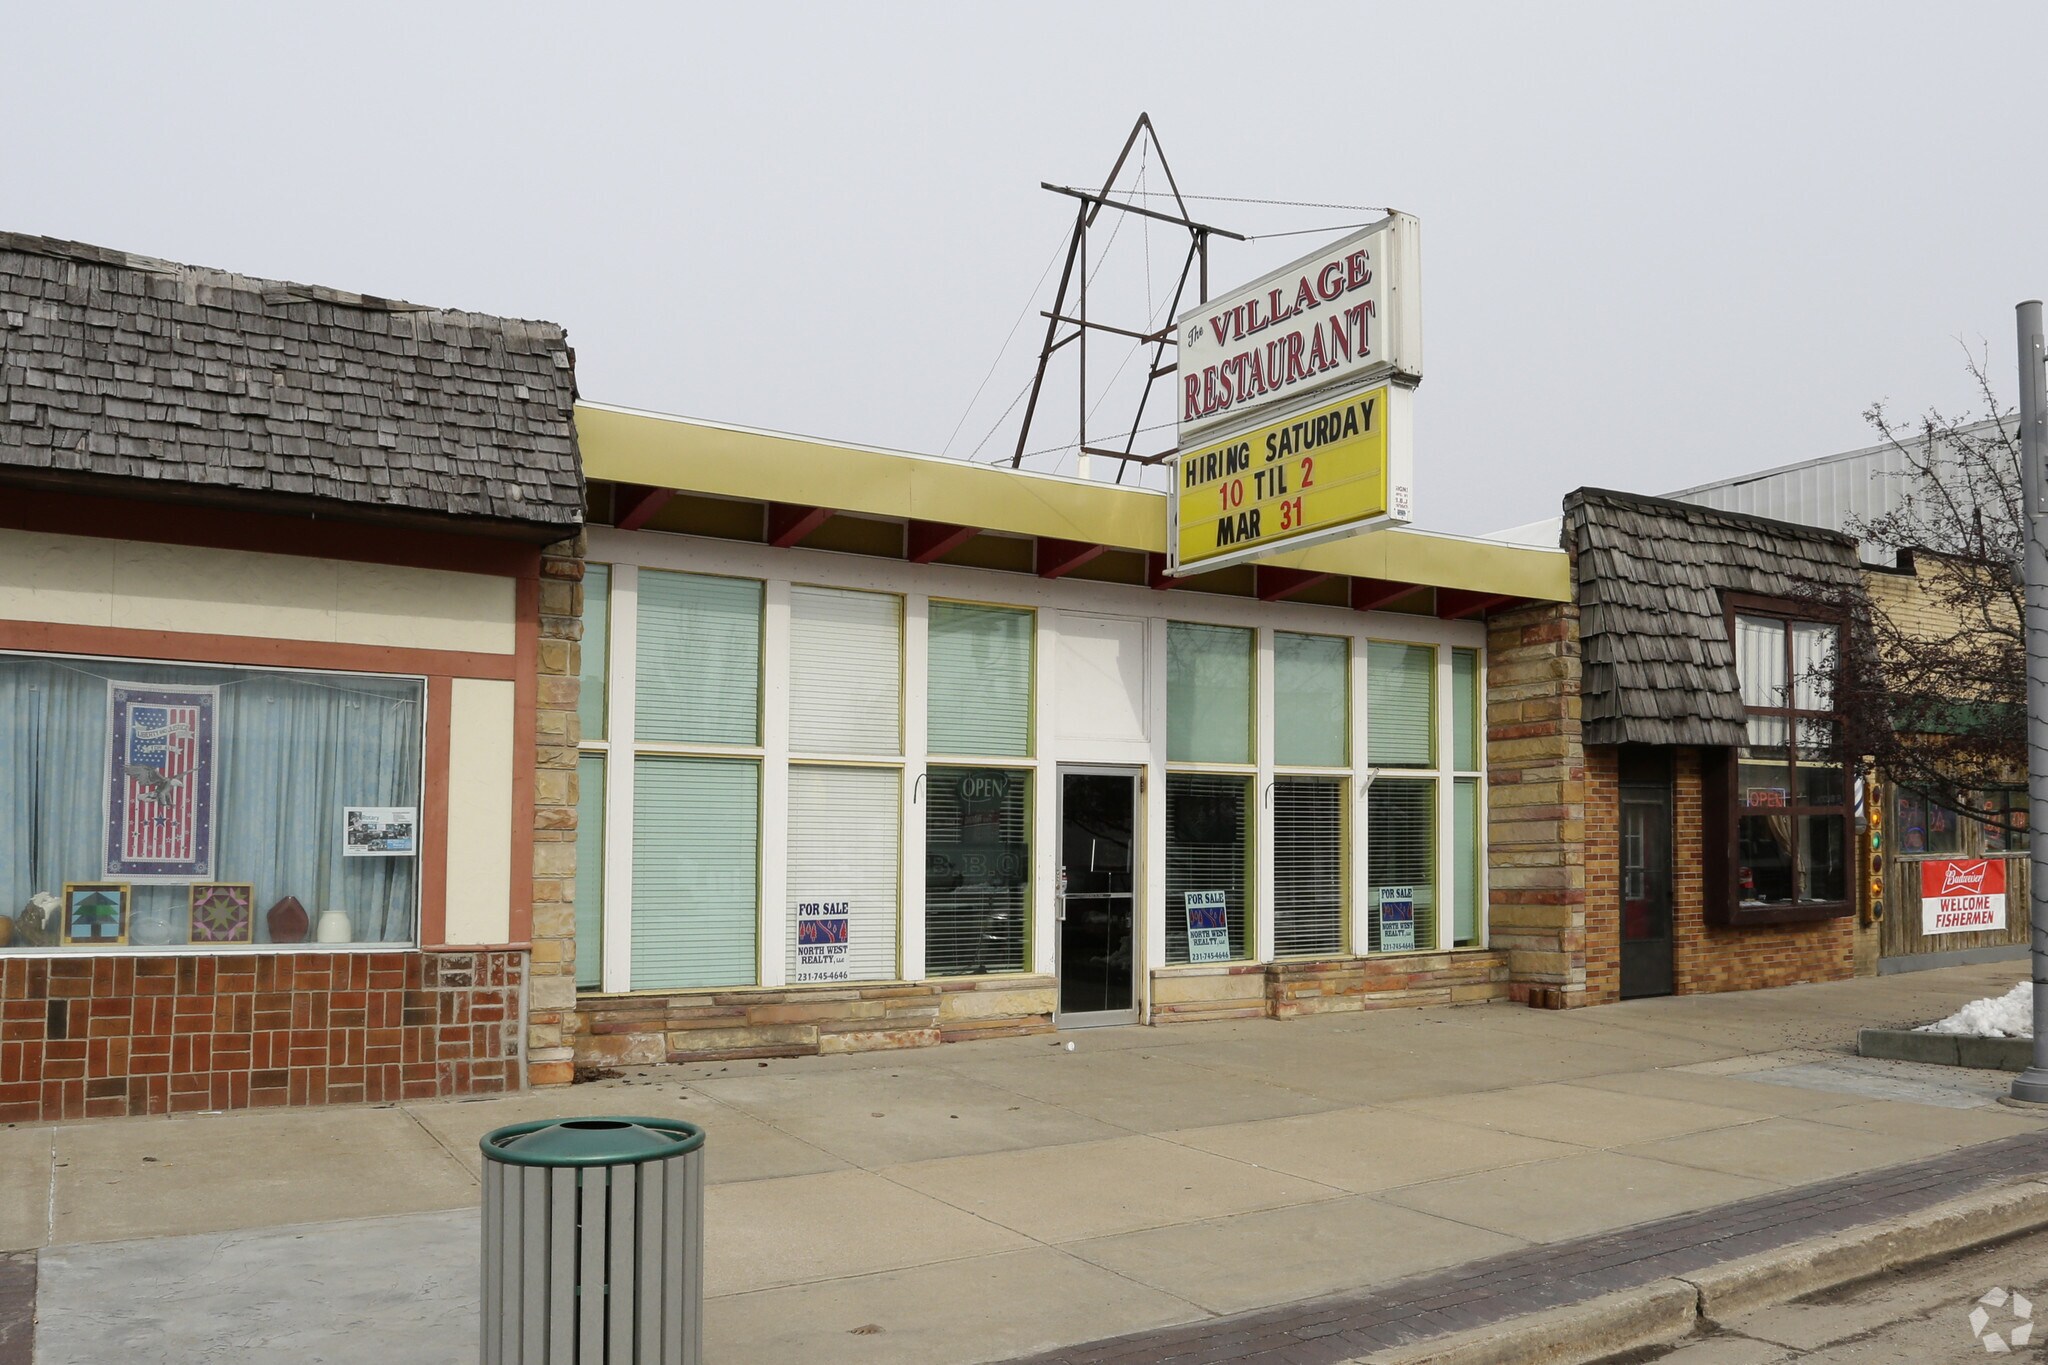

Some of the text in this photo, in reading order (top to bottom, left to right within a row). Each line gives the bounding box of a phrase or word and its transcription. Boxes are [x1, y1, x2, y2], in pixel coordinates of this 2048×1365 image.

[1187, 249, 1373, 348] The VILLAGE
[1184, 300, 1375, 422] RESTAURANT
[1186, 399, 1375, 488] HIRING SATURDAY
[1219, 457, 1314, 511] 10 TIL 2
[1216, 497, 1303, 547] MAR 31
[962, 778, 1003, 797] OPEN
[1750, 791, 1783, 807] OPEN
[1945, 869, 1983, 885] Budweiser
[1187, 893, 1224, 905] FOR SALE
[1381, 888, 1413, 899] FOR SALE
[799, 902, 849, 916] FOR SALE
[1940, 896, 1990, 912] WELCOME
[1936, 911, 1994, 928] FISHERMEN
[798, 945, 848, 955] NORTH WEST
[798, 971, 848, 981] 231-745-4646
